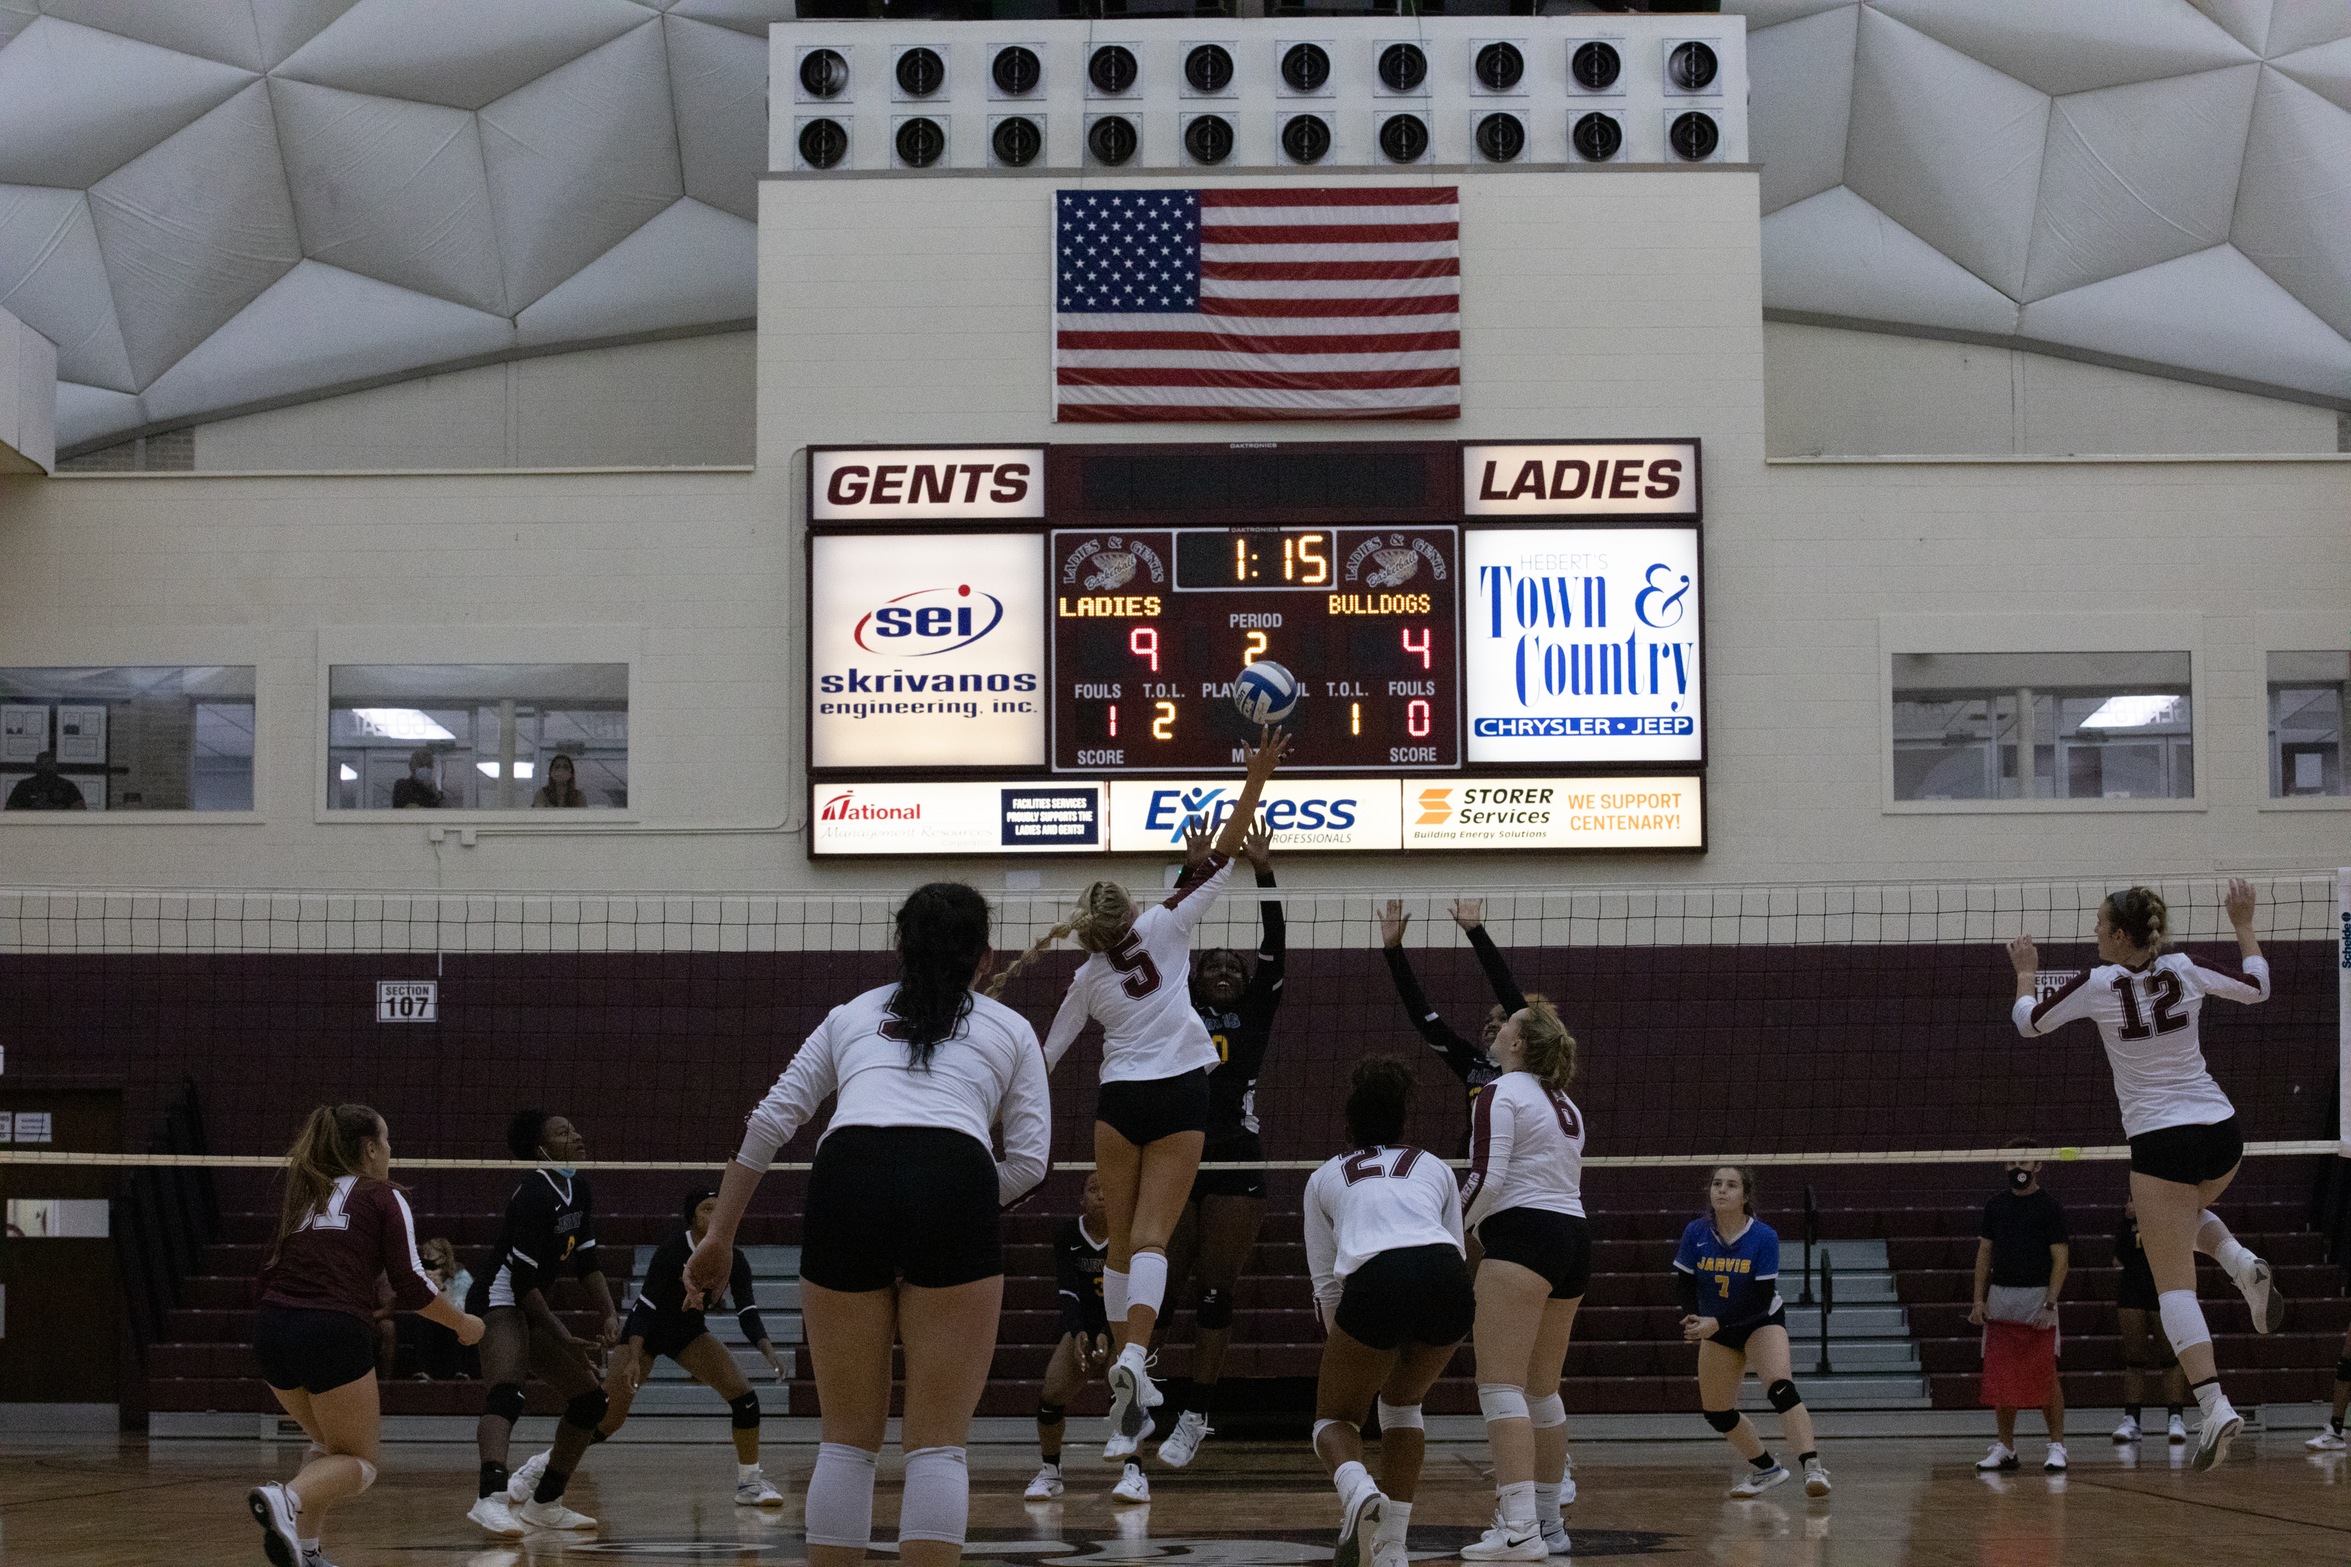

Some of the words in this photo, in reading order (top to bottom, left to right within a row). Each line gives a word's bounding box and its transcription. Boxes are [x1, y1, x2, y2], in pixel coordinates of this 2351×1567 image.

[827, 463, 1031, 506] GENTS
[1479, 459, 1683, 501] LADIES
[1063, 539, 1101, 584] LADIES
[1107, 536, 1123, 549] &
[1130, 541, 1164, 583] GENTS
[1235, 534, 1328, 584] 1:15
[1345, 536, 1382, 581] LADIES
[1390, 533, 1405, 547] &
[1412, 538, 1447, 580] GENTS
[1519, 553, 1609, 570] HEBERT'S
[875, 583, 973, 638] sei
[1059, 596, 1162, 617] LADIES
[1328, 593, 1431, 615] BULLDOGS
[1480, 565, 1607, 639] Town
[1634, 562, 1691, 629] &
[1229, 612, 1283, 628] PERIOD
[1130, 627, 1158, 672] 9
[1243, 631, 1268, 667] 2
[1402, 628, 1430, 670] 4
[1515, 625, 1694, 713] Country
[820, 667, 1038, 694] skrivanos
[1142, 682, 1186, 698] T.O.L.
[1326, 681, 1370, 697] T.O.L.
[1388, 680, 1436, 697] FOULS
[1074, 683, 1122, 699] FOULS
[992, 698, 1039, 714] inc.
[1109, 704, 1117, 738] 1
[1152, 701, 1177, 740] 2
[1351, 701, 1360, 736] 1
[1407, 699, 1431, 737] 0
[1479, 719, 1611, 736] CHRYSLER
[1631, 717, 1690, 734] JEEP
[1077, 749, 1125, 765] SCORE
[1389, 746, 1438, 763] SCORE
[1012, 798, 1051, 810] FACILITIES
[1051, 797, 1087, 809] SERVICES
[1463, 788, 1554, 805] STORER
[1567, 794, 1596, 810] WE
[1600, 793, 1682, 809] SUPPORT
[1077, 810, 1093, 822] THE
[1459, 808, 1551, 825] Services
[1570, 814, 1682, 831] CENTENARY!
[1014, 824, 1041, 836] LADIES
[1272, 832, 1352, 844] ROFESSIONALS
[1413, 830, 1457, 840] Building
[1459, 830, 1495, 840] Energy
[1498, 829, 1548, 839] Solutions
[1105, 928, 1163, 1002] 5
[384, 986, 430, 996] SECTION
[385, 997, 430, 1017] 107
[2110, 966, 2190, 1042] 12
[291, 1175, 360, 1231] 1
[1696, 1256, 1752, 1274] JARVIS
[1714, 1274, 1730, 1299] 7
